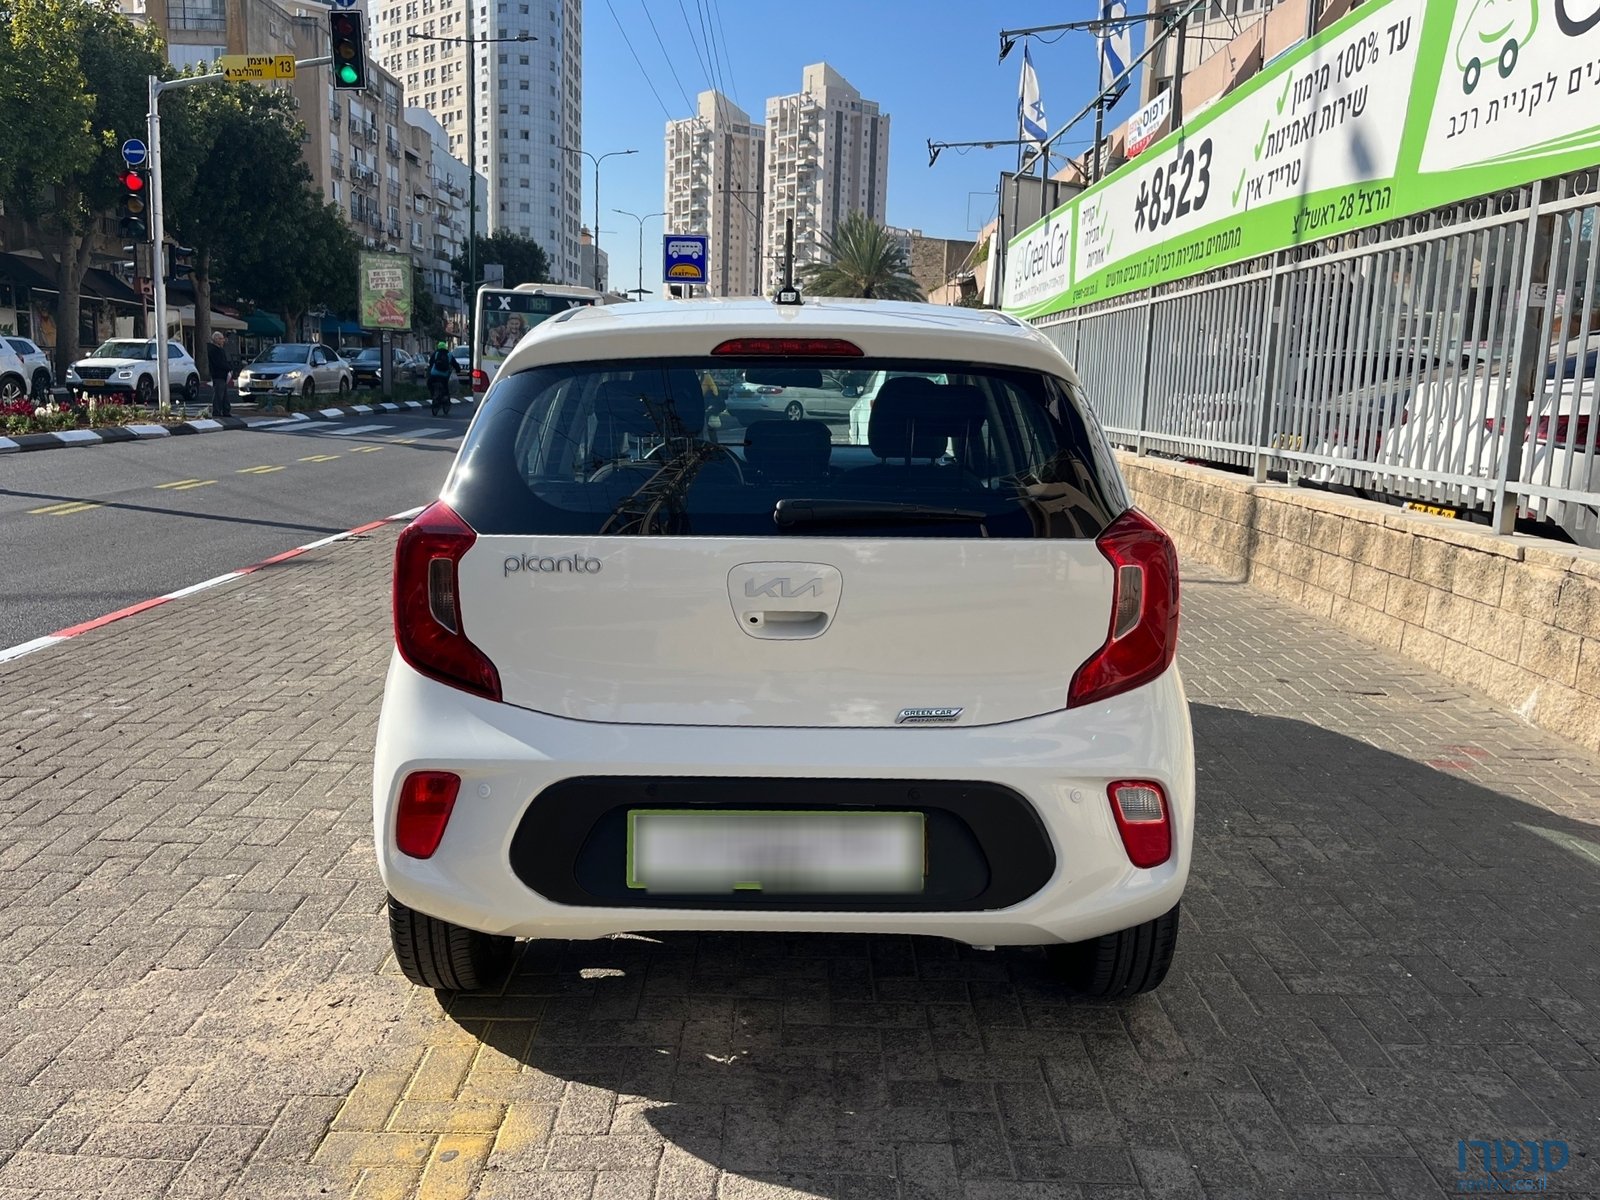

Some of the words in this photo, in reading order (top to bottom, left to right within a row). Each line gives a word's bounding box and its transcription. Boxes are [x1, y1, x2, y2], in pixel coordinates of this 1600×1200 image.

[1387, 16, 1412, 56] עד
[232, 67, 263, 76] מוהליבר
[247, 57, 267, 67] ויצמן
[279, 61, 291, 73] 13
[1336, 31, 1379, 83] 100%
[1292, 63, 1330, 115] מימון
[1486, 71, 1558, 125] לקניית
[1142, 98, 1165, 127] דפוס
[1319, 85, 1369, 134] שירות
[1447, 107, 1479, 139] רכב
[1265, 111, 1317, 159] ואמינות
[1245, 173, 1264, 212] אין
[1268, 158, 1301, 195] טרייד
[1338, 193, 1354, 221] 28
[1358, 186, 1392, 217] הרצל
[1024, 240, 1049, 281] Green
[1050, 223, 1069, 269] Car
[1176, 240, 1204, 269] במכירת
[1206, 226, 1241, 257] מתמחים
[504, 553, 603, 578] picanto
